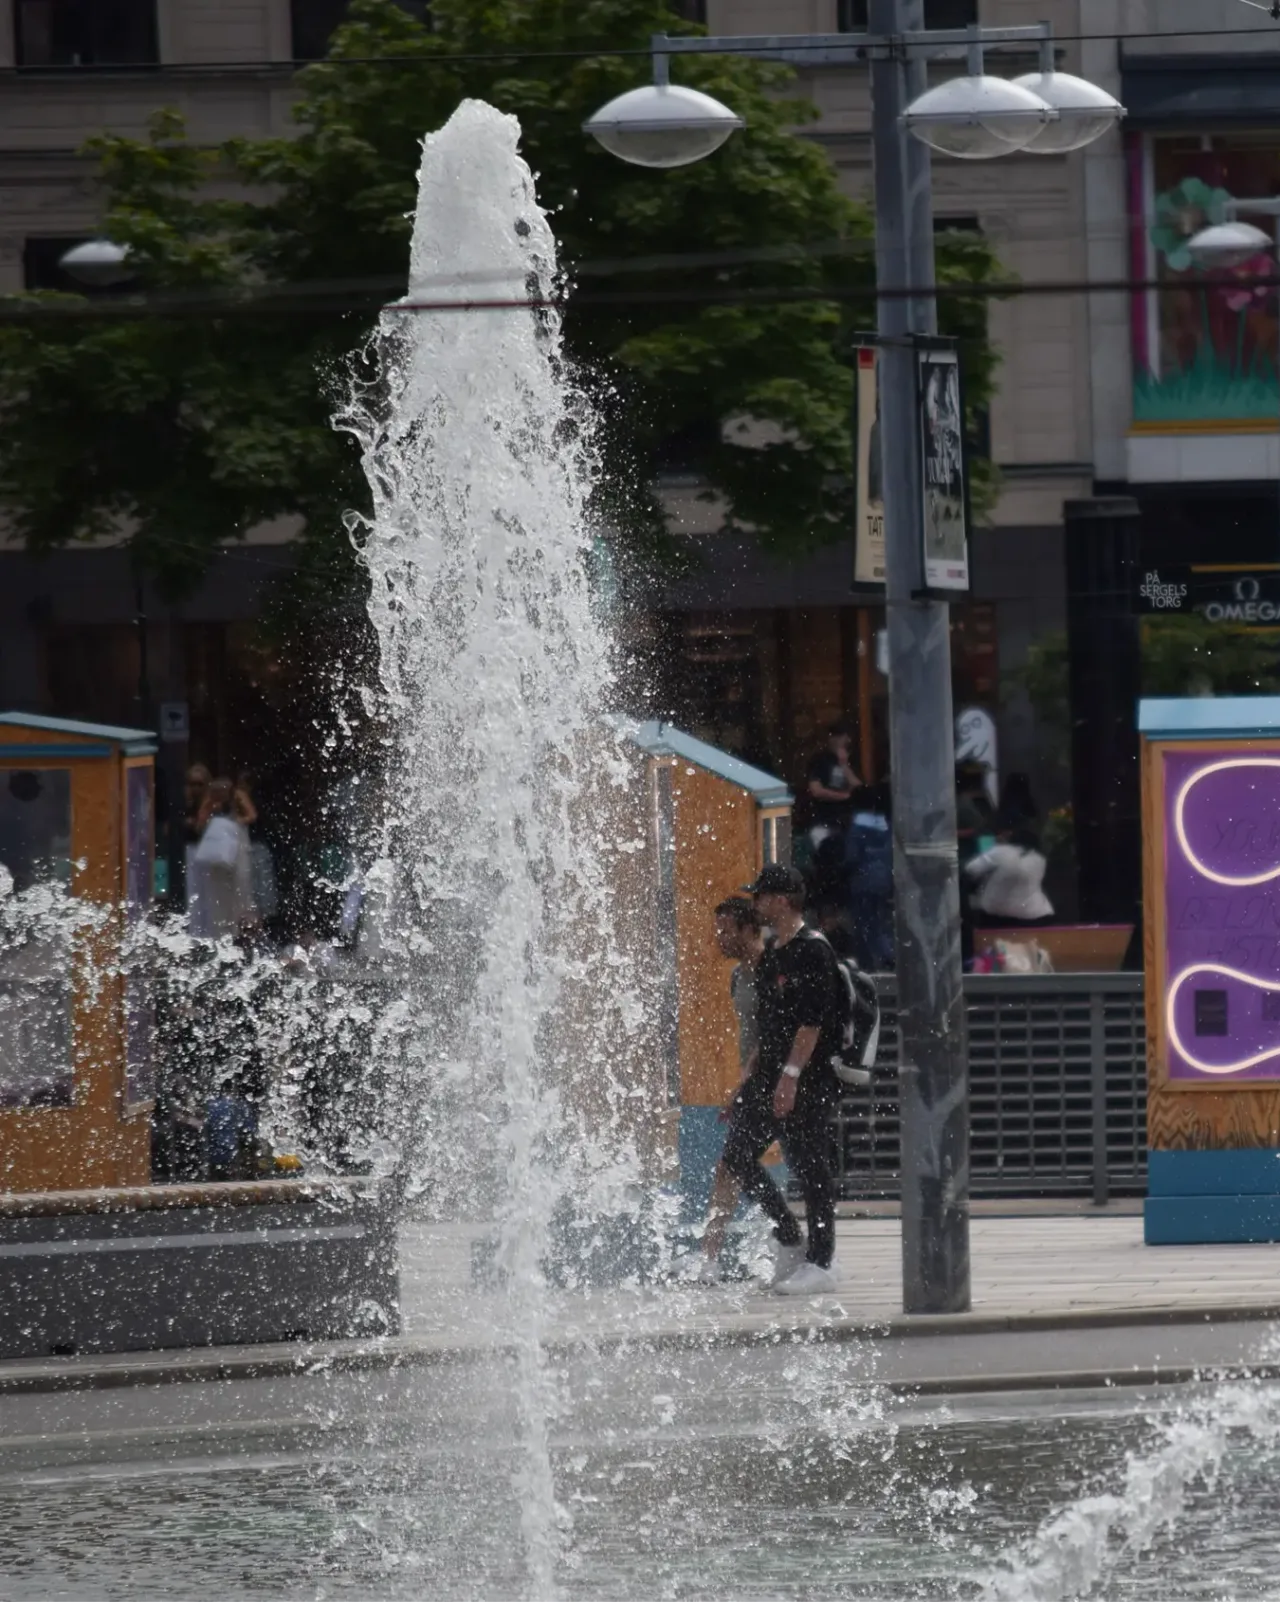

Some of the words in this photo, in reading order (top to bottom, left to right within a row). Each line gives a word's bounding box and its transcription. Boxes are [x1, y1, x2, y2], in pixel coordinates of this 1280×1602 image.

[1146, 570, 1160, 584] PÅ
[1140, 584, 1186, 597] SERGELS
[1150, 597, 1181, 608] TORG
